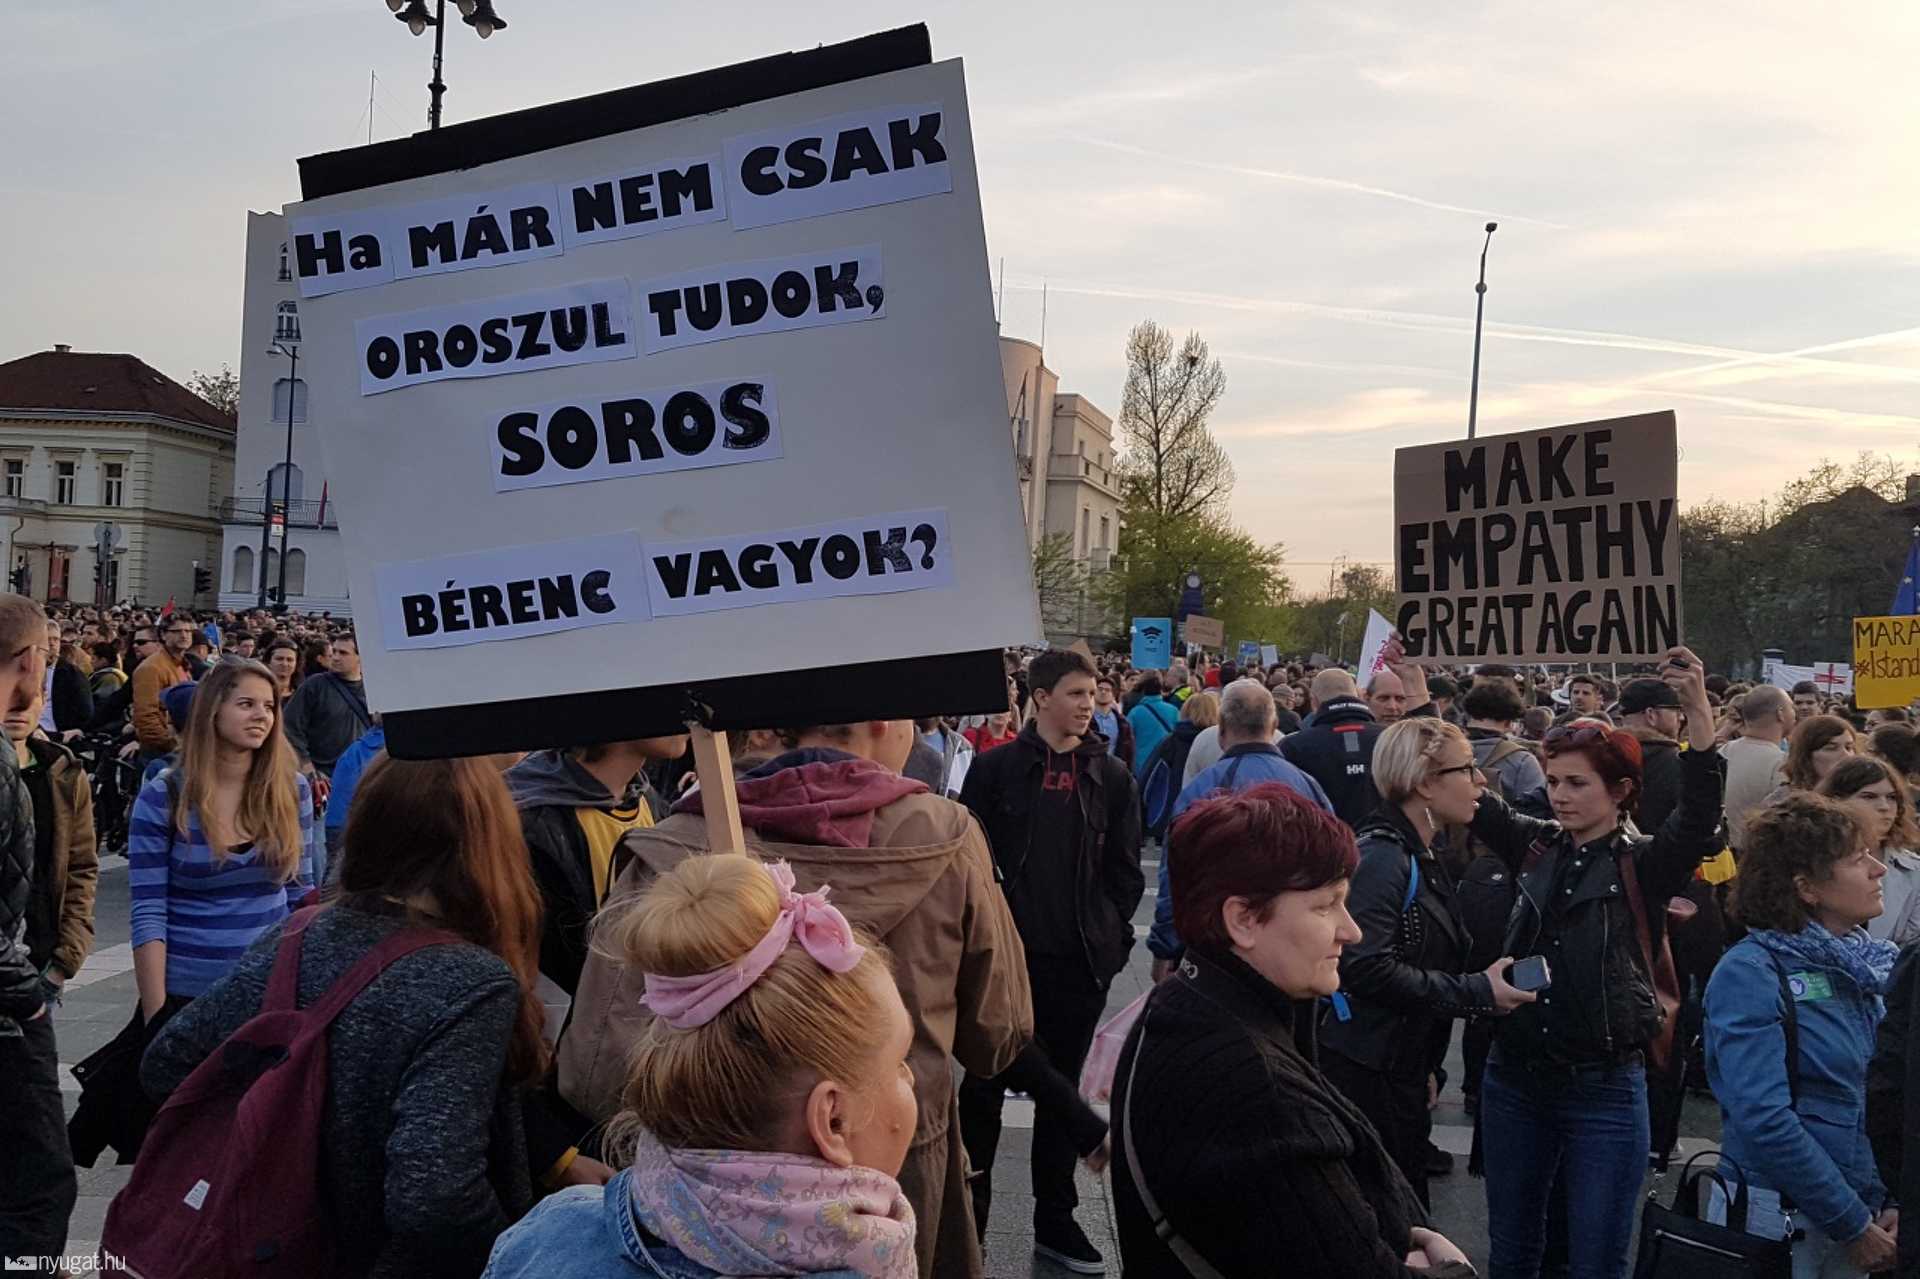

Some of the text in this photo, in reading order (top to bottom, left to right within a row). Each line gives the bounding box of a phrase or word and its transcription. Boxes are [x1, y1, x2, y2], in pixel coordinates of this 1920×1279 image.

[295, 112, 947, 277] Ha MÁR NEM CSAK
[367, 261, 884, 379] OROSZUL TUDOK,
[498, 383, 770, 476] SOROS
[1444, 429, 1615, 513] MAKE
[402, 523, 937, 637] BÉRENC VAGYOK?
[1400, 498, 1674, 593] EMPATHY
[1397, 593, 1534, 657] GREAT
[1535, 584, 1679, 655] AGAIN
